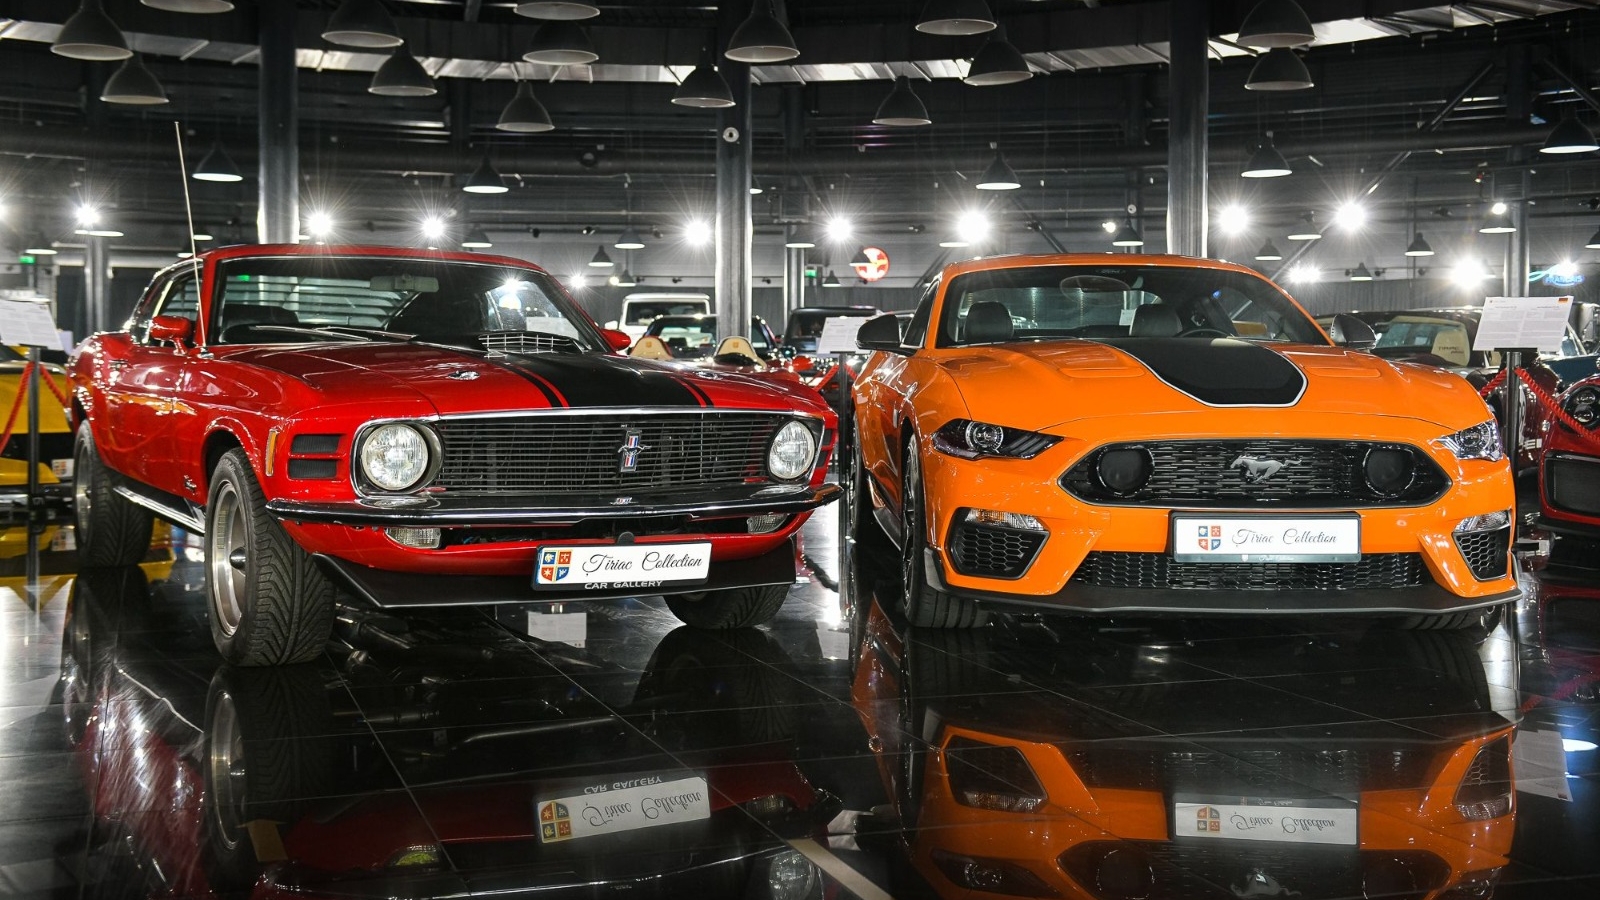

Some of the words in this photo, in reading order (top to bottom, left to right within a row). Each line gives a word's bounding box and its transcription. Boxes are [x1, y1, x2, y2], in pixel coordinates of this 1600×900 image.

[1282, 528, 1337, 545] Collection
[641, 551, 703, 571] Collection
[584, 582, 607, 590] CAR
[613, 580, 663, 589] GALLERY
